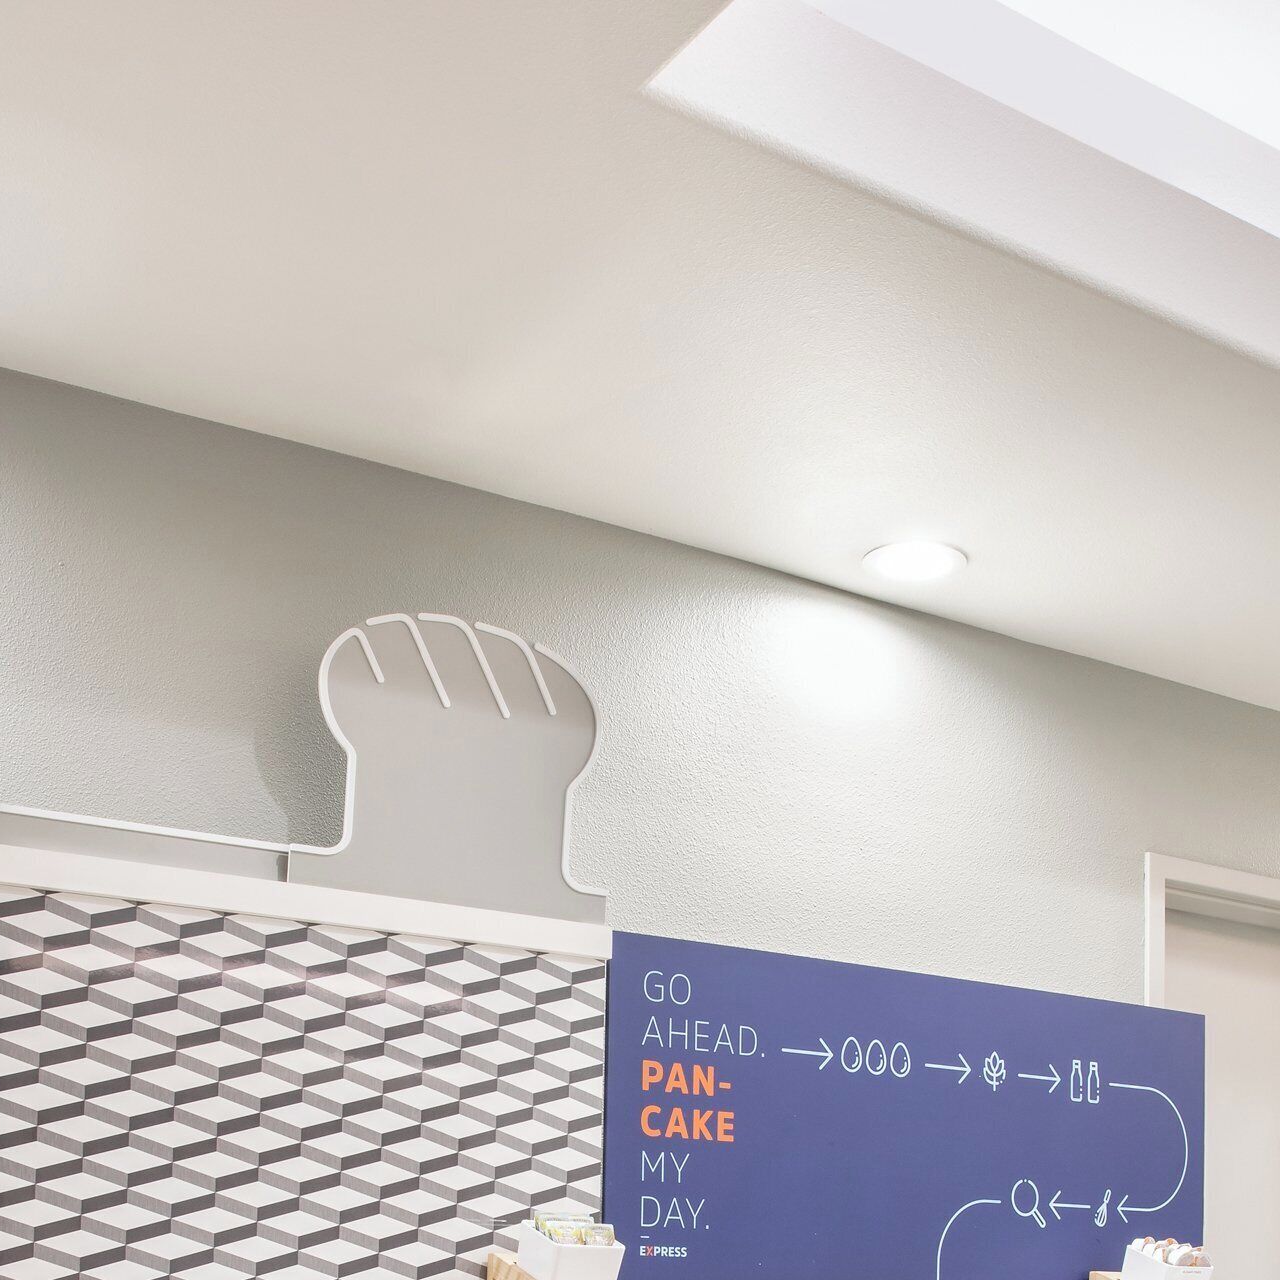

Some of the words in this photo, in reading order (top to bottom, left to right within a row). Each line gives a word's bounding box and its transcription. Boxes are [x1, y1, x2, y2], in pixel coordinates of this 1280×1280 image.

[643, 970, 691, 1005] GO
[641, 1015, 765, 1058] AHEAD.
[642, 1059, 732, 1097] PAN-
[640, 1105, 735, 1142] CAKE
[641, 1150, 690, 1184] MY
[641, 1195, 710, 1230] DAY.
[640, 1245, 688, 1258] EXPRESS
